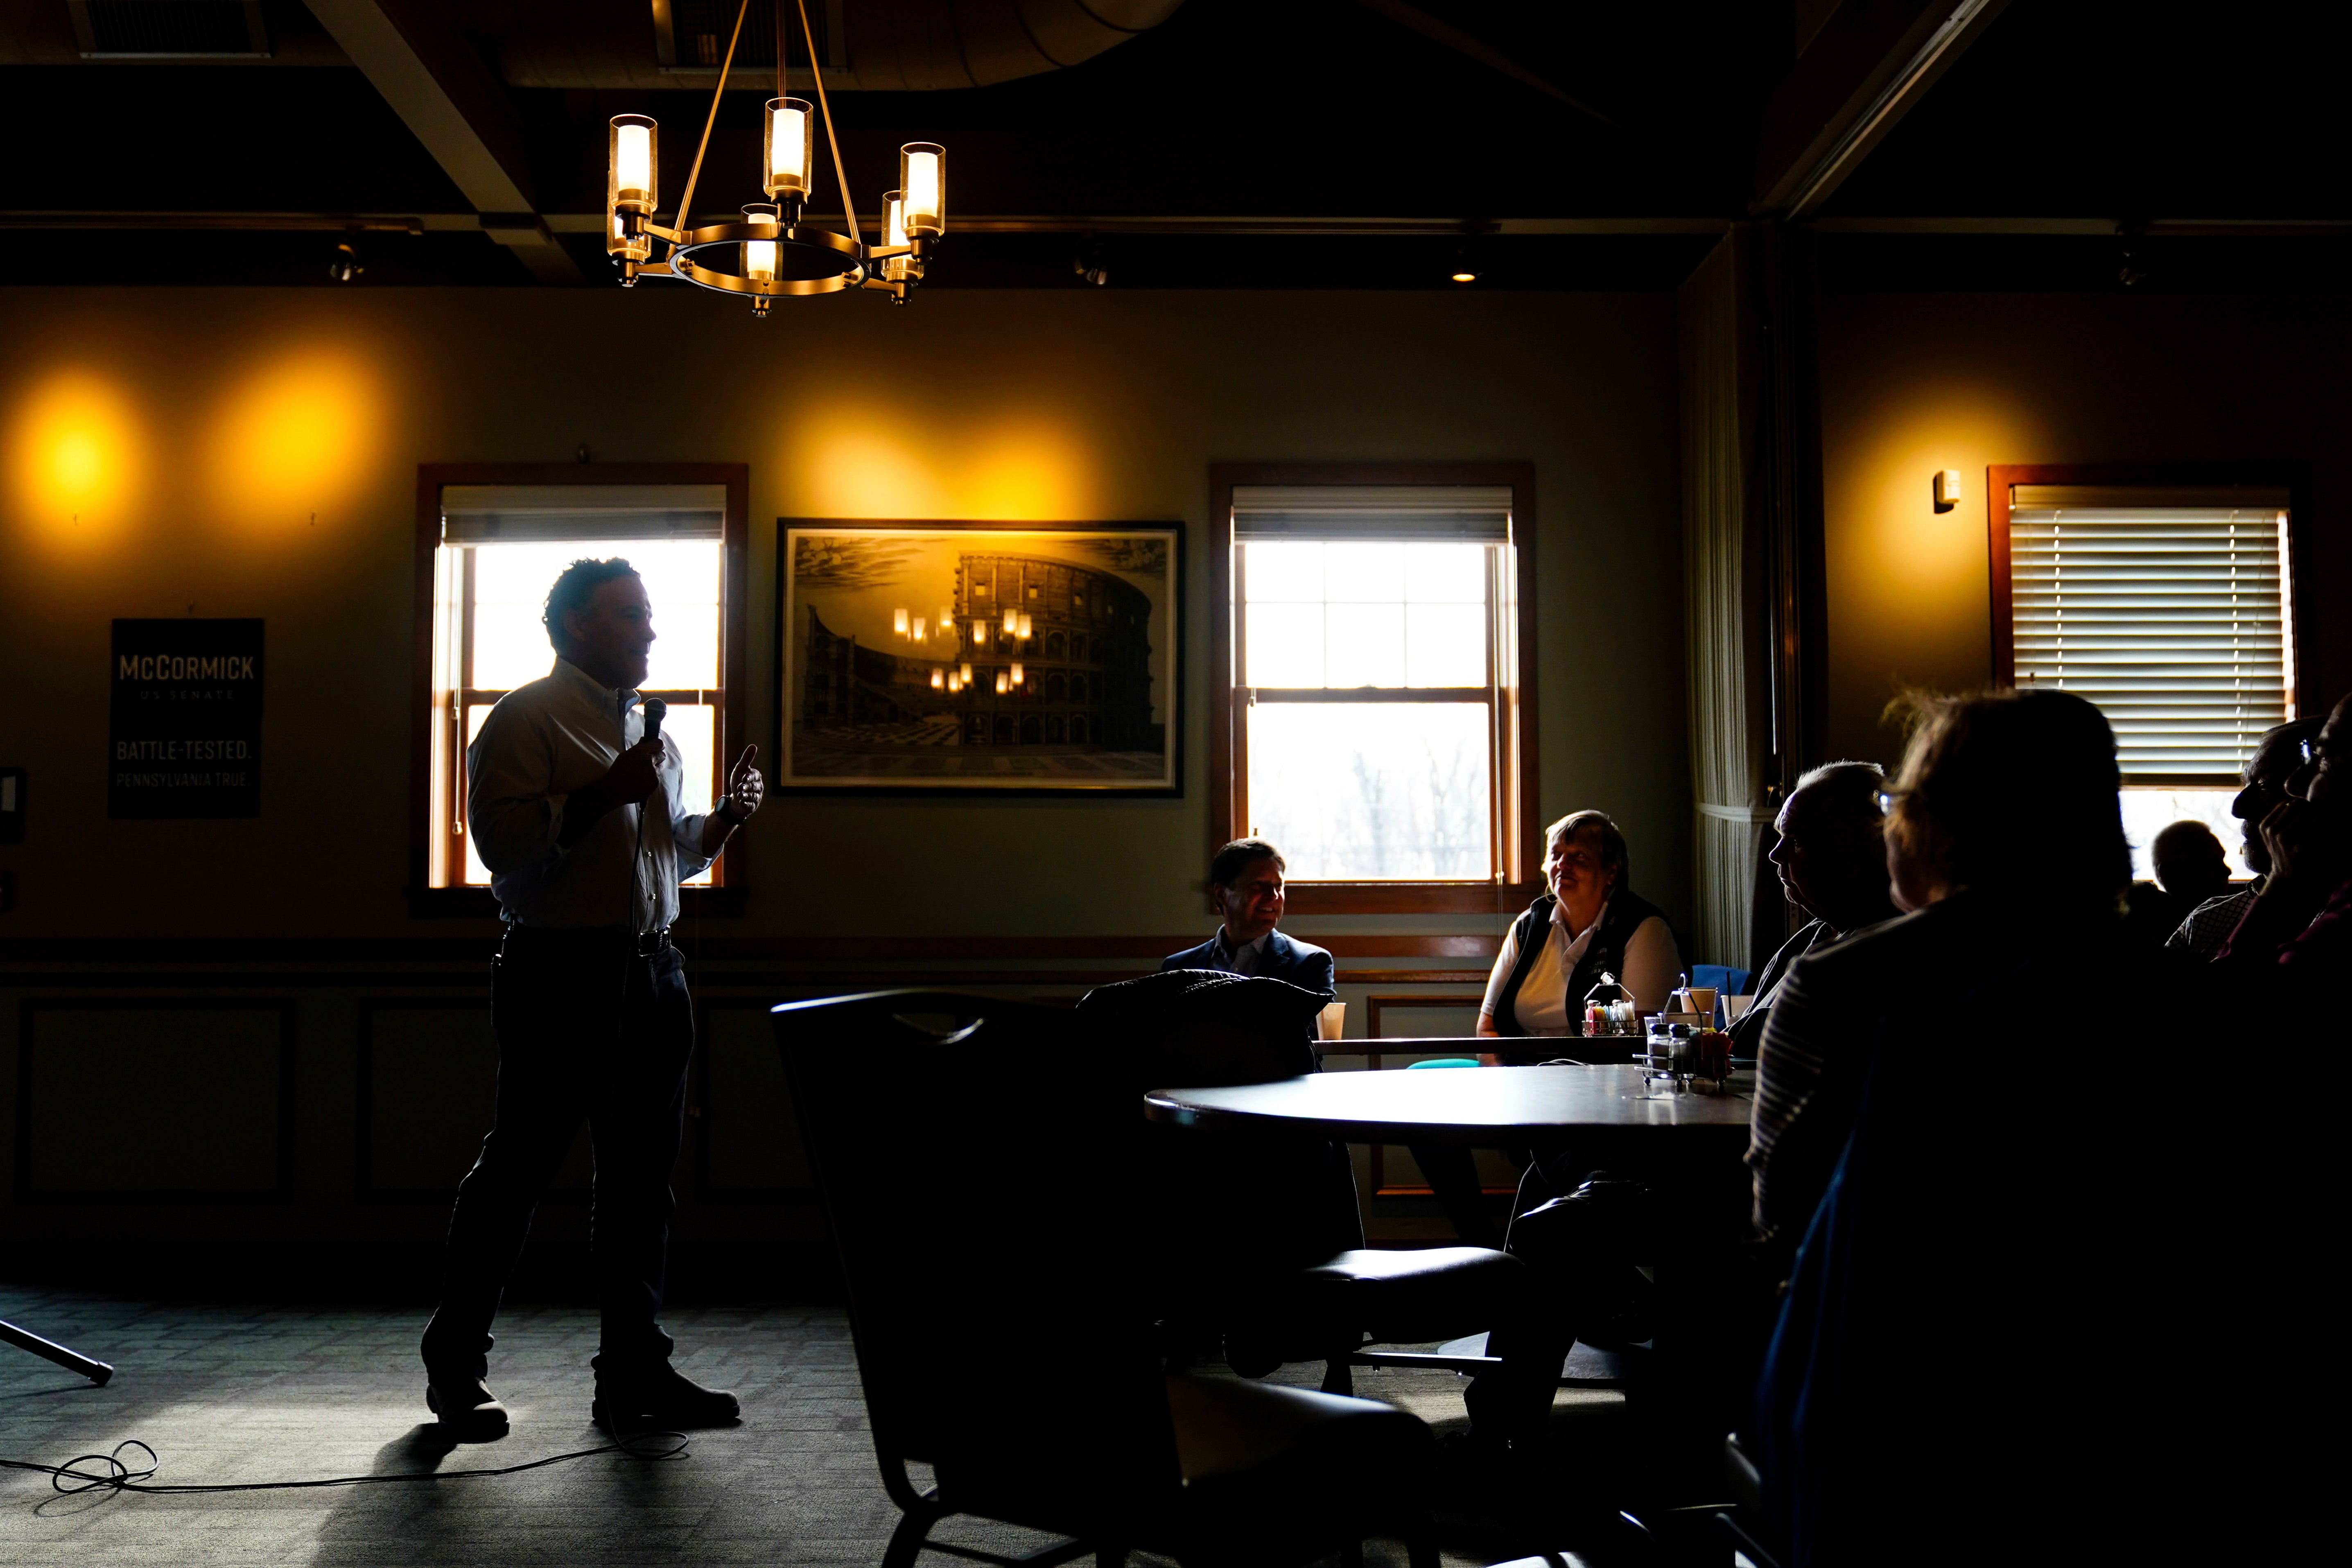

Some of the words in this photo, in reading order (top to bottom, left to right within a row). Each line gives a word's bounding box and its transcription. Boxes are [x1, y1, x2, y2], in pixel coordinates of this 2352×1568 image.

[140, 690, 160, 700] US
[169, 690, 235, 700] SENATE
[117, 740, 252, 760] BATTLE-TESTED.
[116, 773, 211, 787] PENNSYLVANIA
[216, 772, 251, 787] TRUE.
